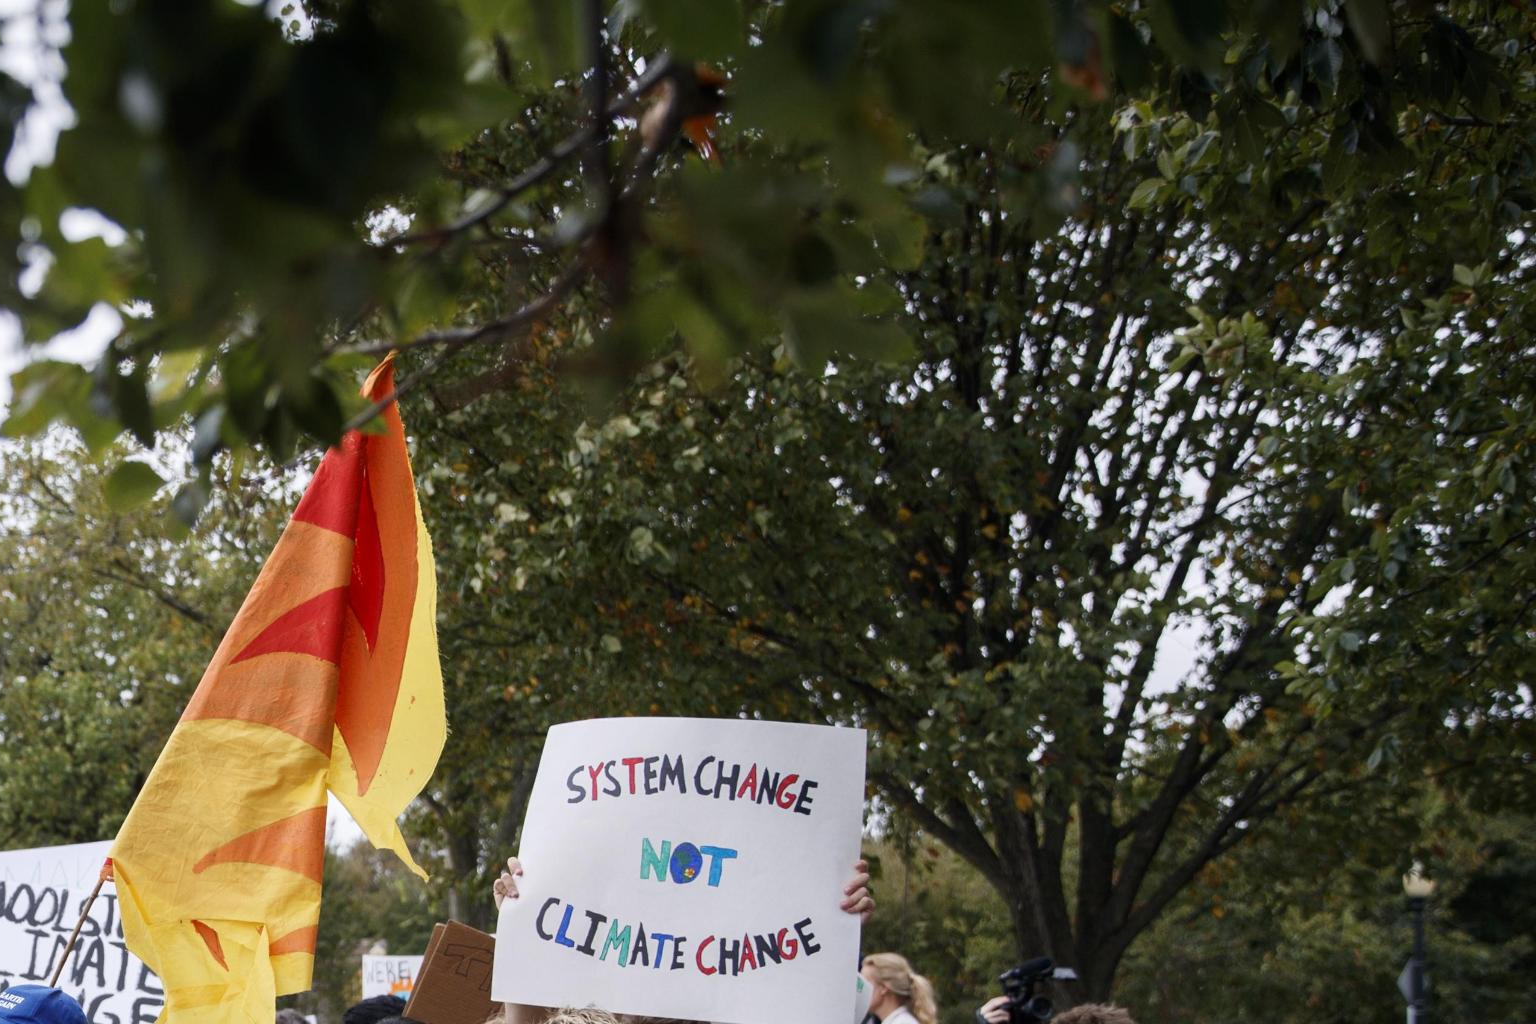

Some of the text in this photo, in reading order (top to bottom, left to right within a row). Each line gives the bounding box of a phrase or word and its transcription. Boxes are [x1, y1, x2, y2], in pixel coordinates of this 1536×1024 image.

[567, 754, 818, 815] SYSTEM CHANGE
[640, 837, 737, 887] NOT
[536, 897, 686, 970] CLIMATE
[696, 917, 821, 976] CHANGE
